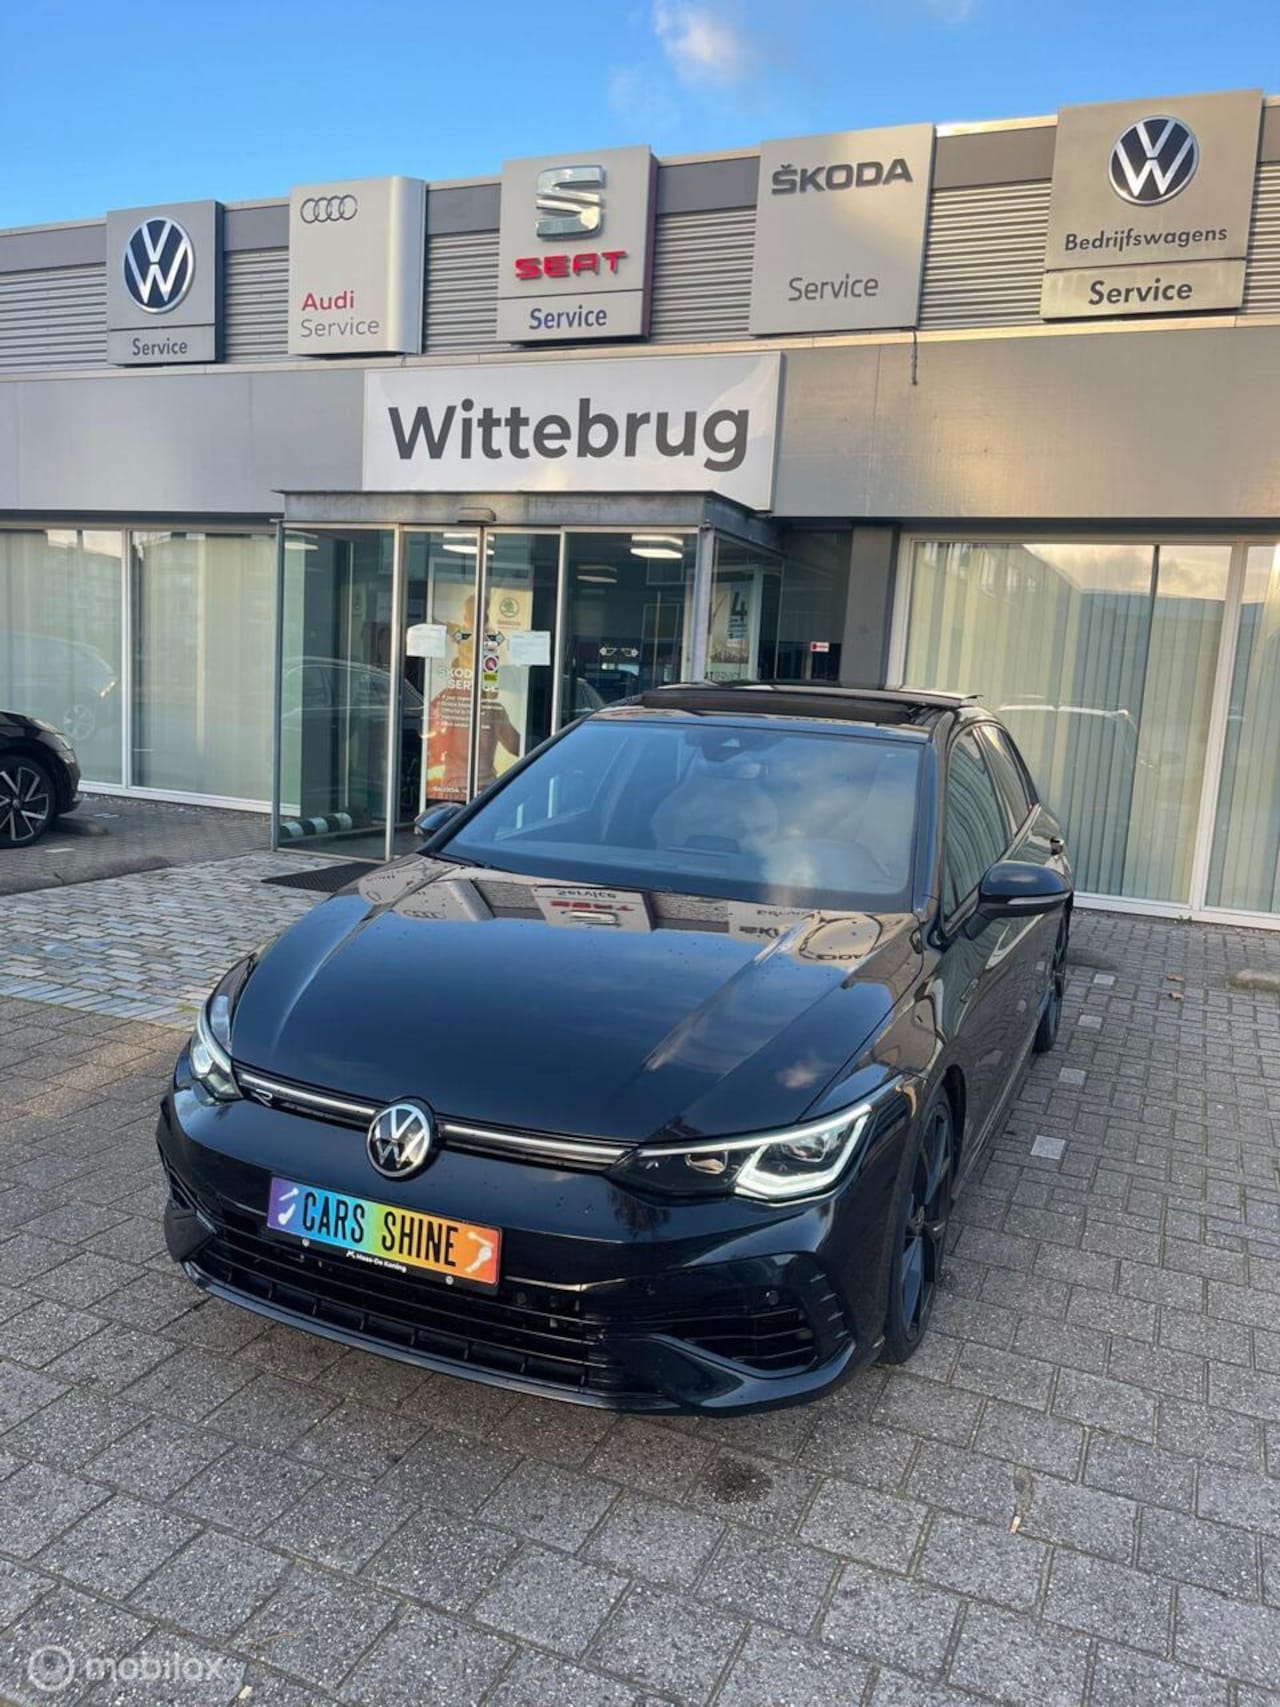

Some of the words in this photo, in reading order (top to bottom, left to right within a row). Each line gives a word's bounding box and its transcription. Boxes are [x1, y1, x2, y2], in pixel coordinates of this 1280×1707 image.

[771, 158, 913, 195] ŠKODA
[1065, 228, 1228, 251] Bedrijfswagens
[514, 251, 627, 280] SEAT
[302, 290, 355, 311] Audi
[788, 273, 879, 301] Service
[1088, 277, 1193, 305] Service
[300, 317, 379, 338] Service
[529, 304, 607, 330] Service
[132, 337, 188, 356] Service
[388, 398, 749, 472] Wittebrug
[302, 1191, 365, 1243] CARS
[382, 1211, 459, 1267] SHINE
